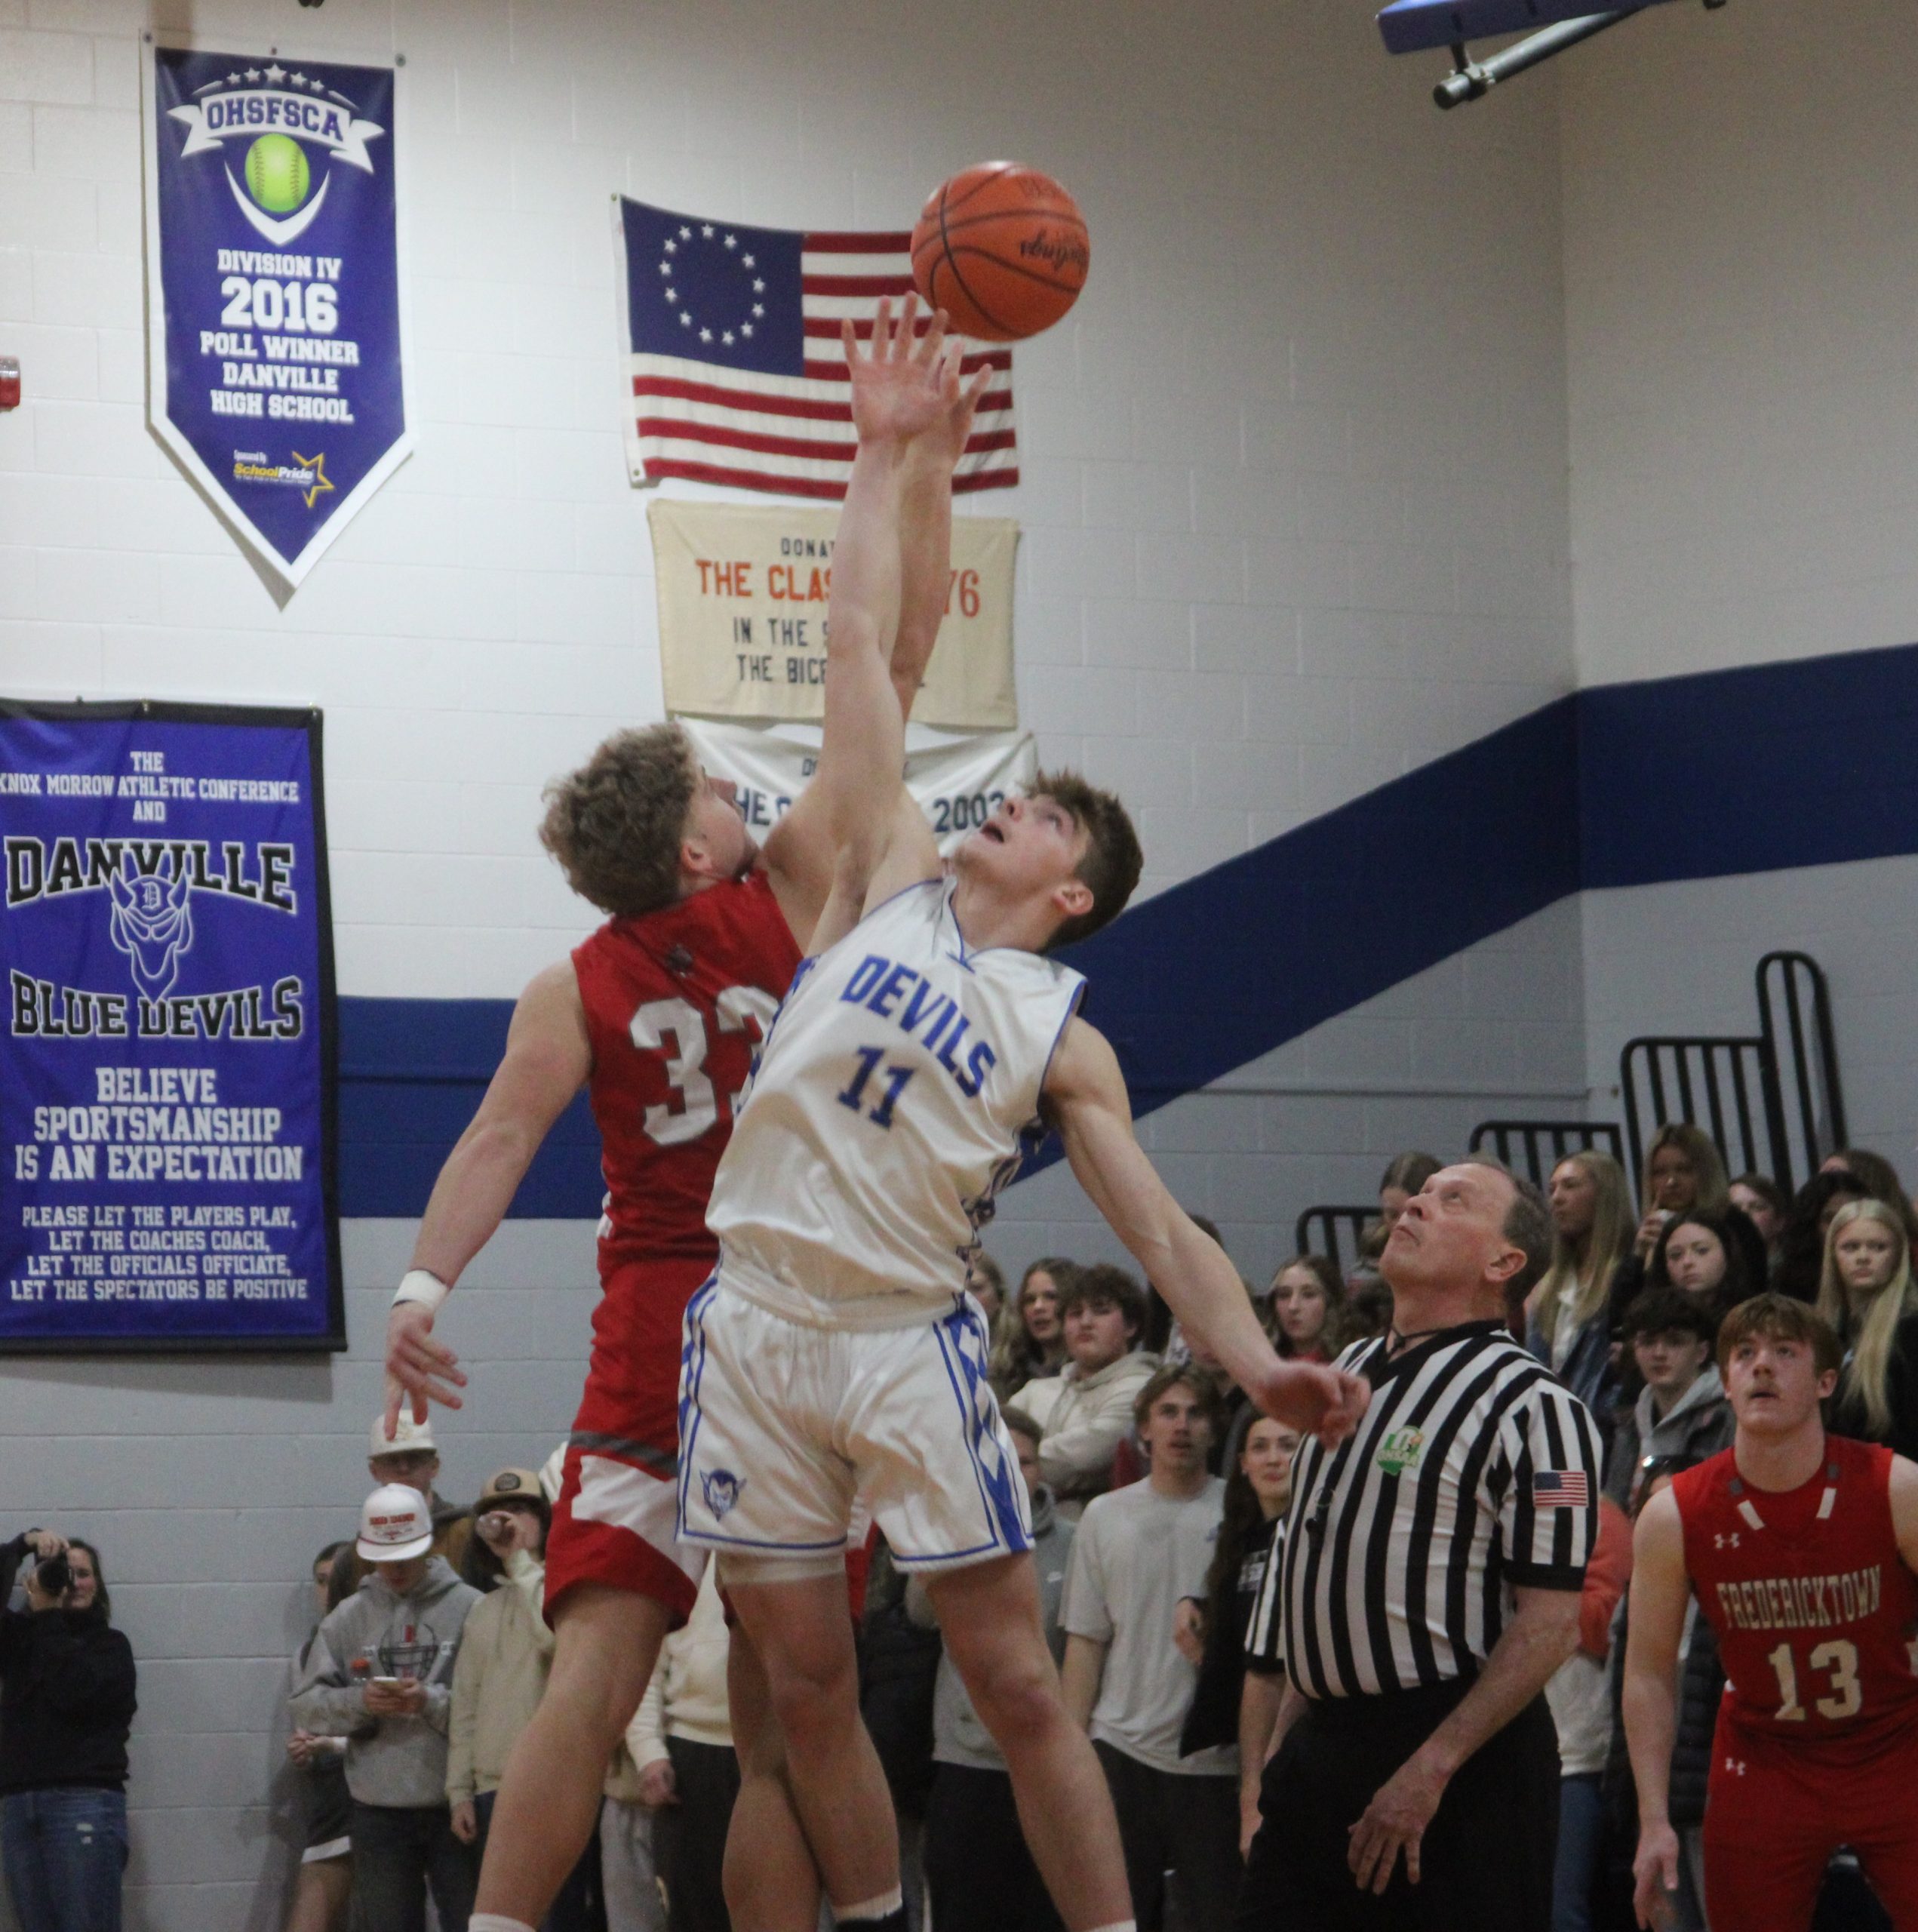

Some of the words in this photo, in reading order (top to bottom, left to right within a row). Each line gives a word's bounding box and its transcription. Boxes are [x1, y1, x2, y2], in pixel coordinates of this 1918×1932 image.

[207, 96, 343, 141] OHSFSCA
[217, 249, 312, 277] DIVISION
[317, 257, 342, 281] IV
[221, 276, 338, 333] 2016
[200, 331, 257, 357] POLL
[263, 335, 359, 365] WINNER
[223, 361, 338, 392] DANVILLE
[211, 389, 263, 416] HIGH
[268, 394, 354, 423] SCHOOL
[234, 463, 314, 479] SchoolPride
[695, 558, 752, 597] THE
[733, 617, 752, 643] IN
[768, 618, 808, 646] THE
[736, 654, 773, 681] THE
[131, 752, 164, 771] THE
[0, 773, 41, 794] KNOX
[46, 774, 114, 795] MORROW
[118, 777, 195, 798] ATHLETIC
[199, 780, 299, 801] CONFERENCE
[133, 801, 165, 822] AND
[4, 836, 297, 915] DANVILLE
[11, 968, 128, 1035] BLUE
[138, 975, 303, 1039] DEVILS
[840, 954, 996, 1098] DEVILS
[96, 1068, 217, 1103] BELIEVE
[838, 1046, 914, 1130] 11
[34, 1106, 281, 1142] SPORTSMANSHIP
[15, 1145, 38, 1180] IS
[50, 1145, 95, 1180] AN
[107, 1145, 302, 1181] EXPECTATION
[23, 1206, 88, 1227] PLEASE
[94, 1207, 126, 1226] LET
[132, 1207, 164, 1226] THE
[171, 1207, 244, 1226] PLAYERS
[250, 1206, 297, 1229] PLAY,
[49, 1231, 84, 1251] LET
[91, 1231, 124, 1251] THE
[130, 1231, 205, 1251] COACHES
[211, 1231, 270, 1253] COACH,
[28, 1255, 63, 1275] LET
[71, 1255, 104, 1275] THE
[110, 1255, 197, 1275] OFFICIALS
[203, 1254, 290, 1277] OFFICIATE,
[11, 1280, 46, 1300] LET
[54, 1280, 88, 1300] THE
[94, 1279, 199, 1300] SPECTATORS
[205, 1279, 227, 1300] BE
[233, 1279, 308, 1300] POSITIVE
[1716, 1564, 1882, 1630] FREDERICKTOWN
[1769, 1639, 1863, 1721] 13
